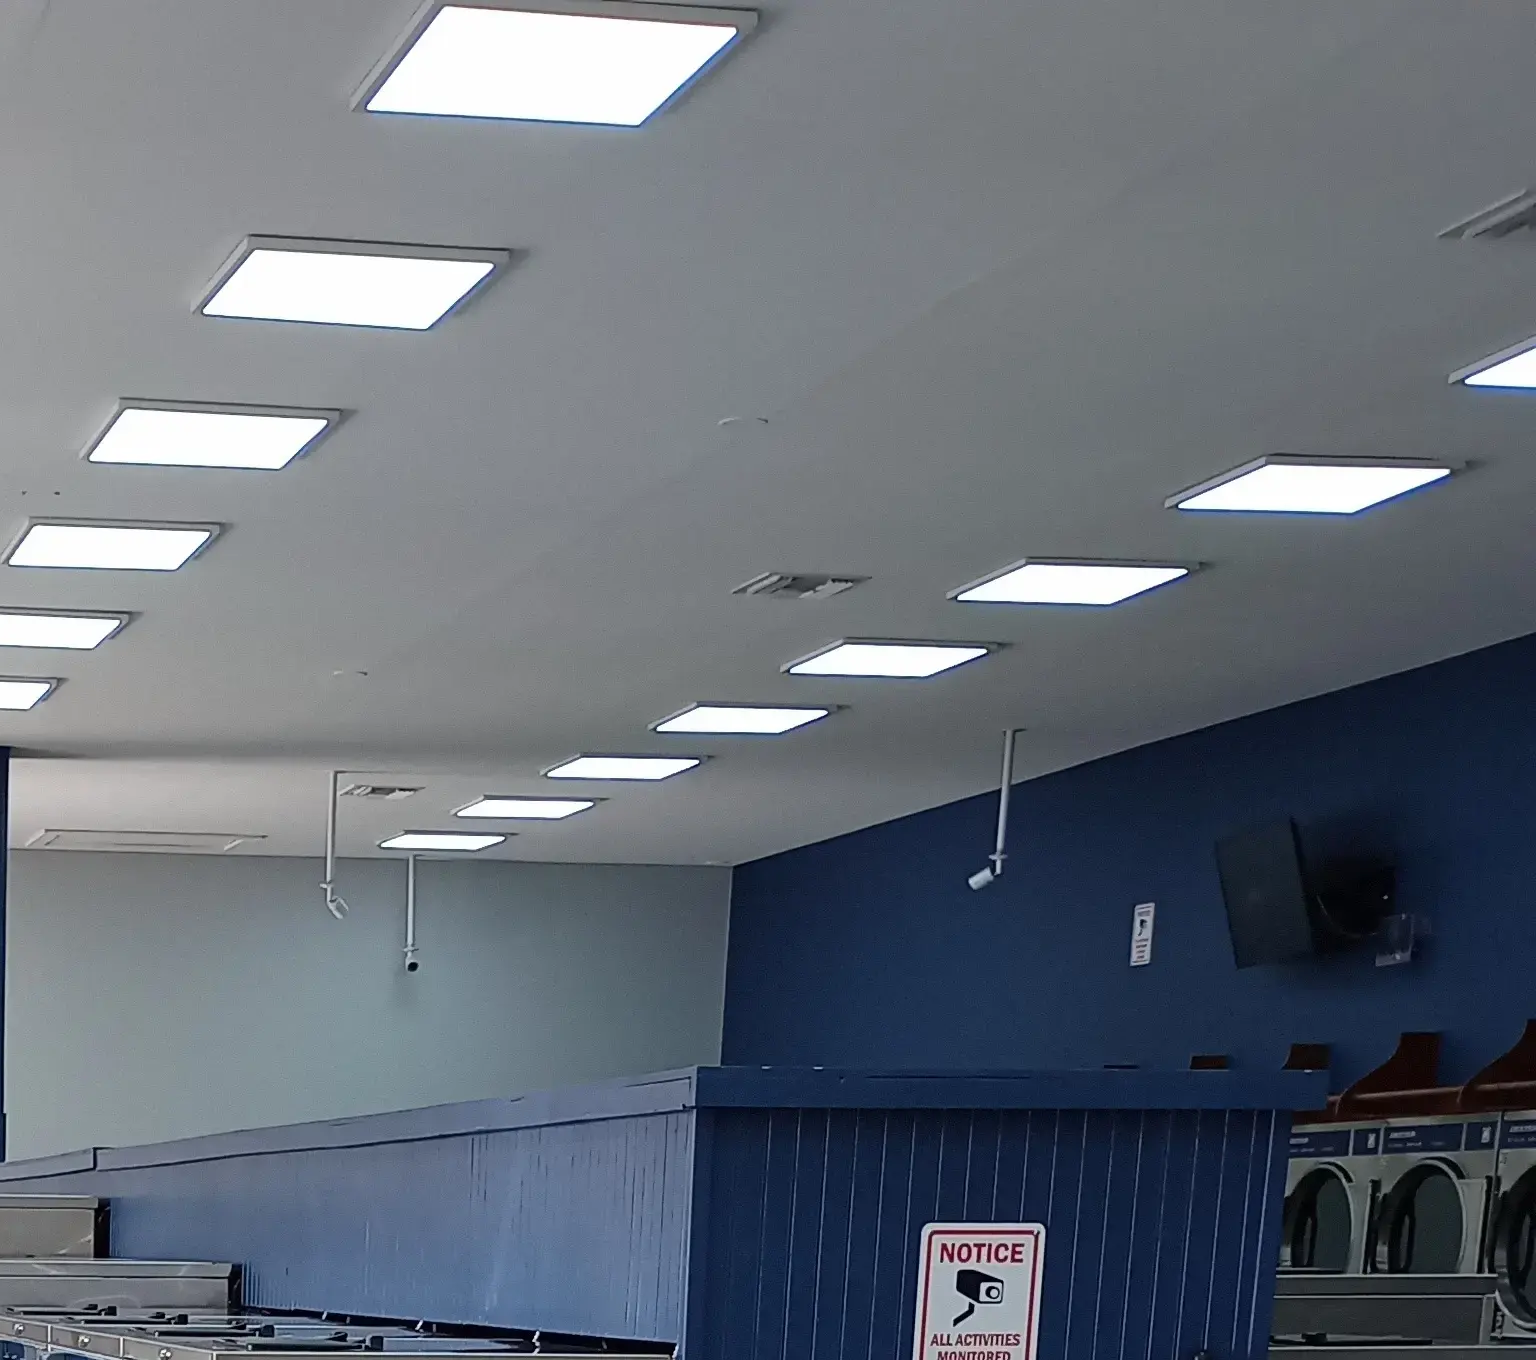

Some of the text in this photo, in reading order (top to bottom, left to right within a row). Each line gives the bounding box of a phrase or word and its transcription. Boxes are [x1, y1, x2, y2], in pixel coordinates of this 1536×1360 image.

[939, 1243, 1025, 1263] NOTICE
[930, 1333, 1021, 1347] ALL ACTIVITIES
